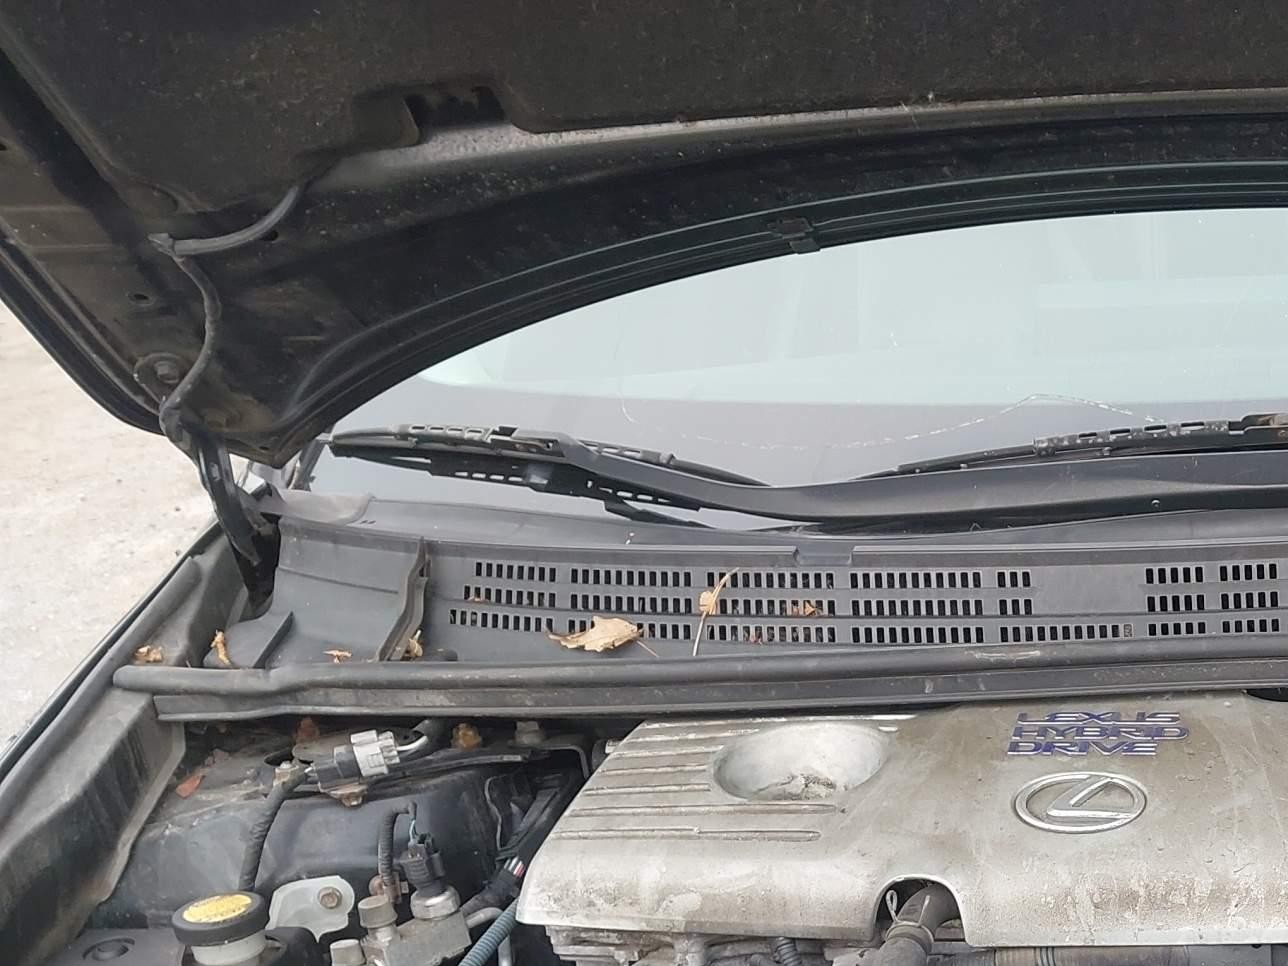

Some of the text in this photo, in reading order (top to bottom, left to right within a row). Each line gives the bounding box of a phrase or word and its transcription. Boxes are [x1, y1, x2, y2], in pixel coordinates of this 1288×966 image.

[1017, 712, 1181, 725] LEXUS
[1012, 726, 1190, 740] HYBRID
[1007, 741, 1158, 756] DRIVE
